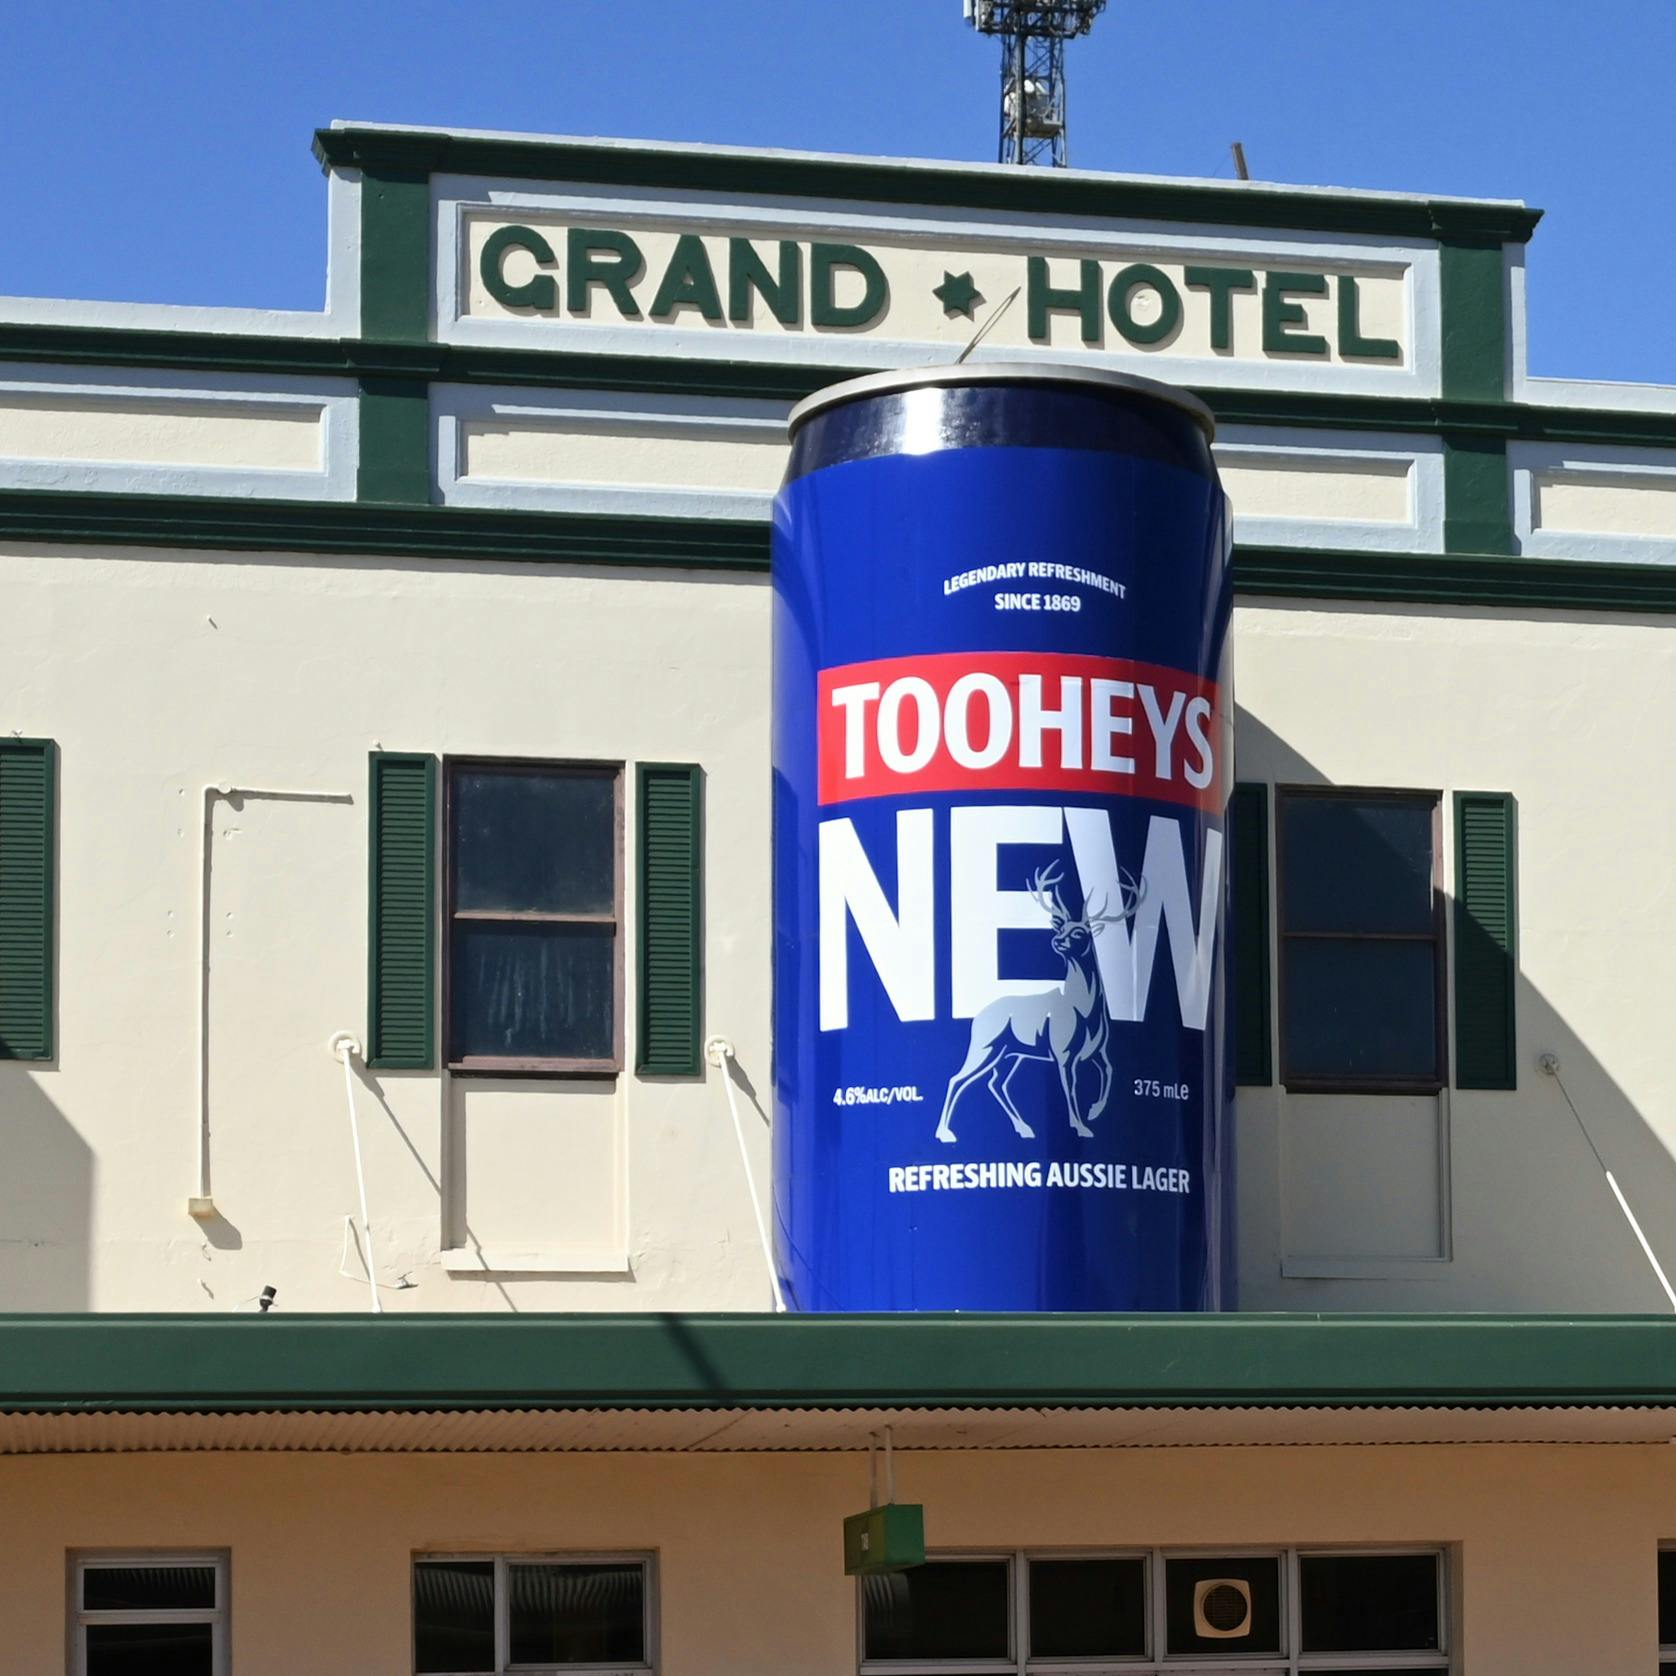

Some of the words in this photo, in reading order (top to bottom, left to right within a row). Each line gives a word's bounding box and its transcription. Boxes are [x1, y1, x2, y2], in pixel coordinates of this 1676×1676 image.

[479, 225, 889, 328] GRAND
[1027, 255, 1400, 358] HOTEL
[943, 562, 1026, 596] LEGENDARY
[1027, 561, 1127, 600] REFRESHMENT
[994, 593, 1041, 611] SINCE
[1043, 594, 1082, 612] 1869
[831, 672, 1214, 790] TOOHEYS
[818, 806, 1223, 1032] NEW
[1133, 1079, 1160, 1098] 375
[888, 1162, 1042, 1193] REFRESHING
[1046, 1162, 1128, 1189] AUSSIE
[1131, 1165, 1191, 1194] LAGER
